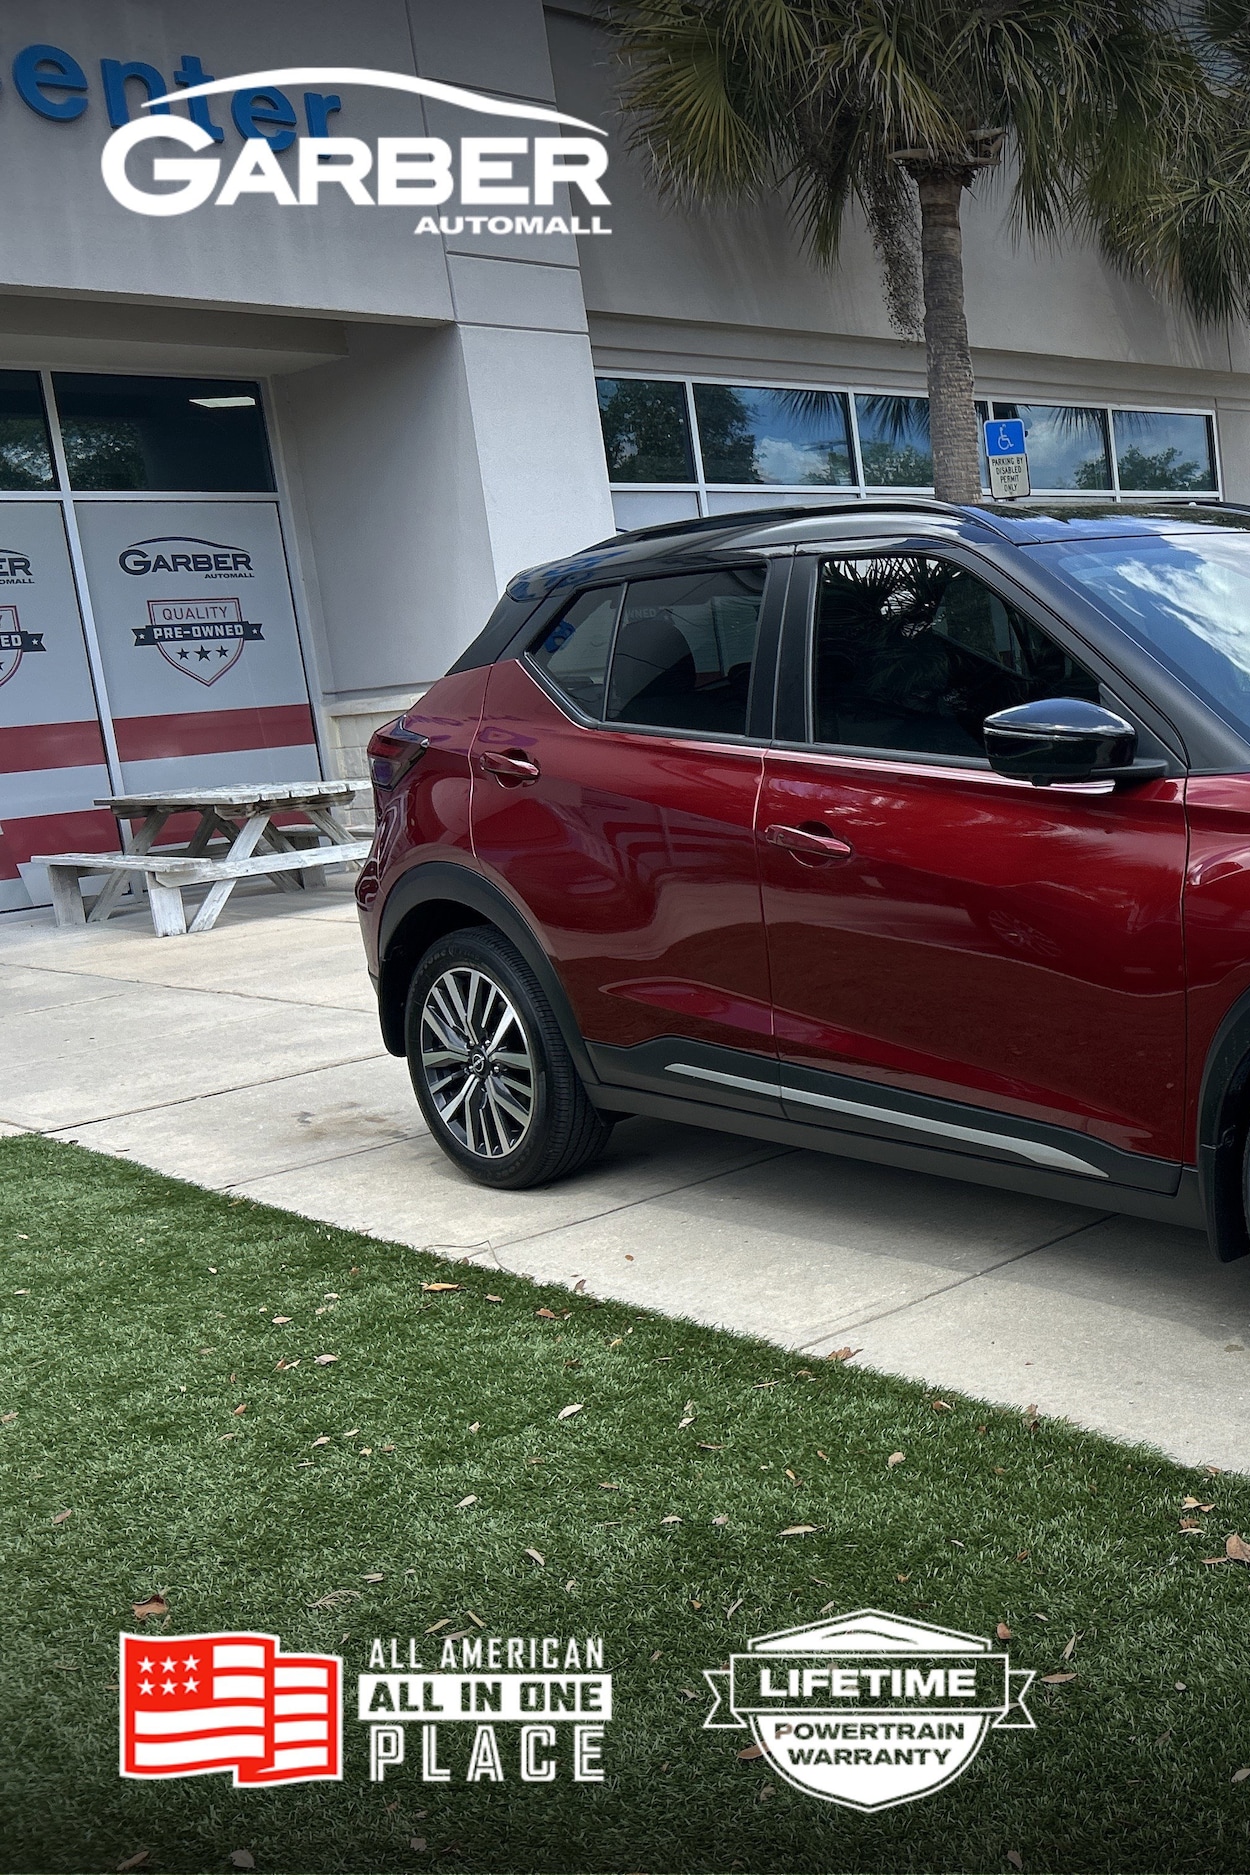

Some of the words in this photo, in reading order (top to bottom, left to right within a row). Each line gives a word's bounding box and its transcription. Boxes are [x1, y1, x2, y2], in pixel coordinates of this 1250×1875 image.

[0, 44, 341, 160] enter
[991, 457, 1015, 467] PARKING
[1016, 456, 1023, 465] BY
[995, 465, 1022, 475] DISABLED
[1000, 474, 1020, 484] PERMIT
[1003, 483, 1017, 492] ONLY
[118, 548, 254, 576] GARBER
[204, 571, 256, 579] AUTOMALL
[161, 605, 228, 621] QUALITY
[152, 623, 245, 640] PRE-OWNED
